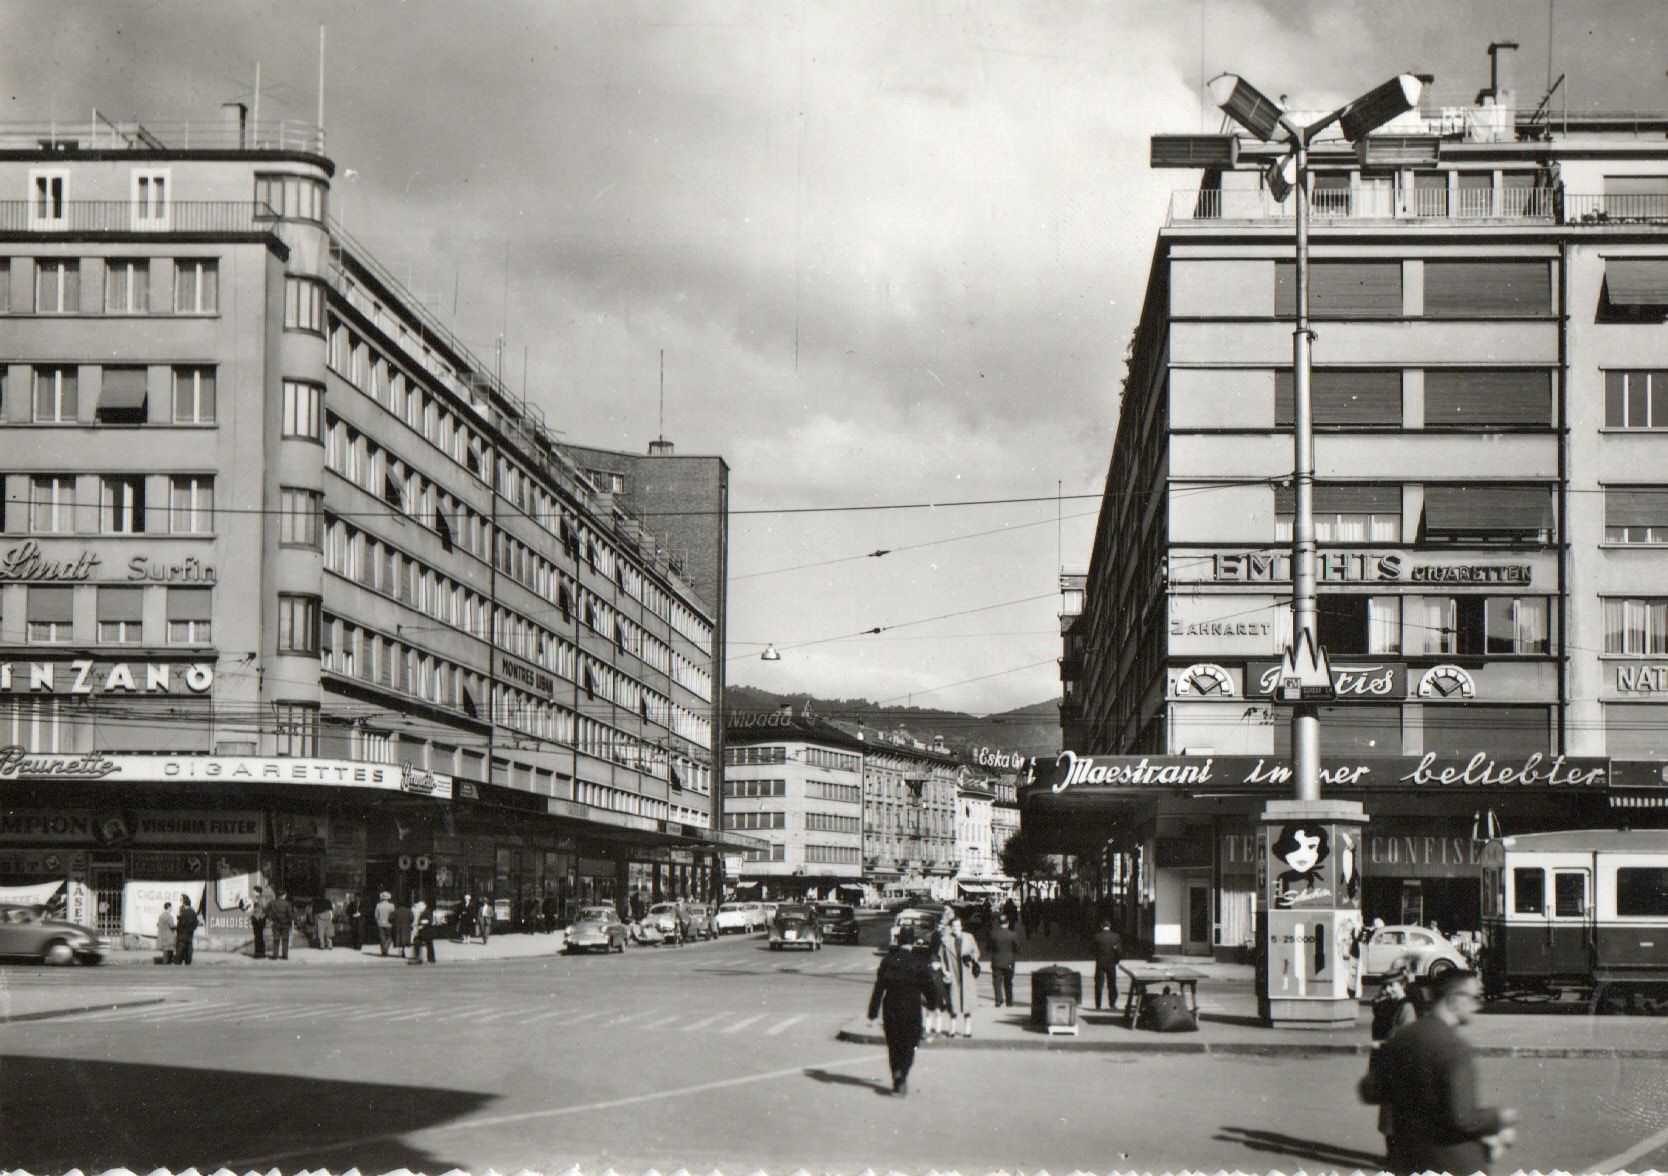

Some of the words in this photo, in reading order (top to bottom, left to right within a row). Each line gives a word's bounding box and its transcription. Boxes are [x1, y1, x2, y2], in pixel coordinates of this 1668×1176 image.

[0, 538, 101, 580] Lindt
[128, 556, 217, 581] Surfin
[1213, 553, 1400, 581] EMHIS
[1170, 622, 1270, 636] ZAHNARZT
[502, 657, 534, 687] MONTRES
[728, 708, 793, 728] Nivada
[0, 745, 122, 779] Brunette
[164, 761, 384, 784] CIGARETTES
[979, 746, 1010, 769] Eska
[1052, 750, 1213, 794] Maestrani
[1400, 752, 1606, 784] beliebter
[210, 820, 257, 835] FILTER
[1226, 836, 1254, 863] TE
[1371, 837, 1482, 864] CONFISE
[136, 889, 181, 902] CIGARE
